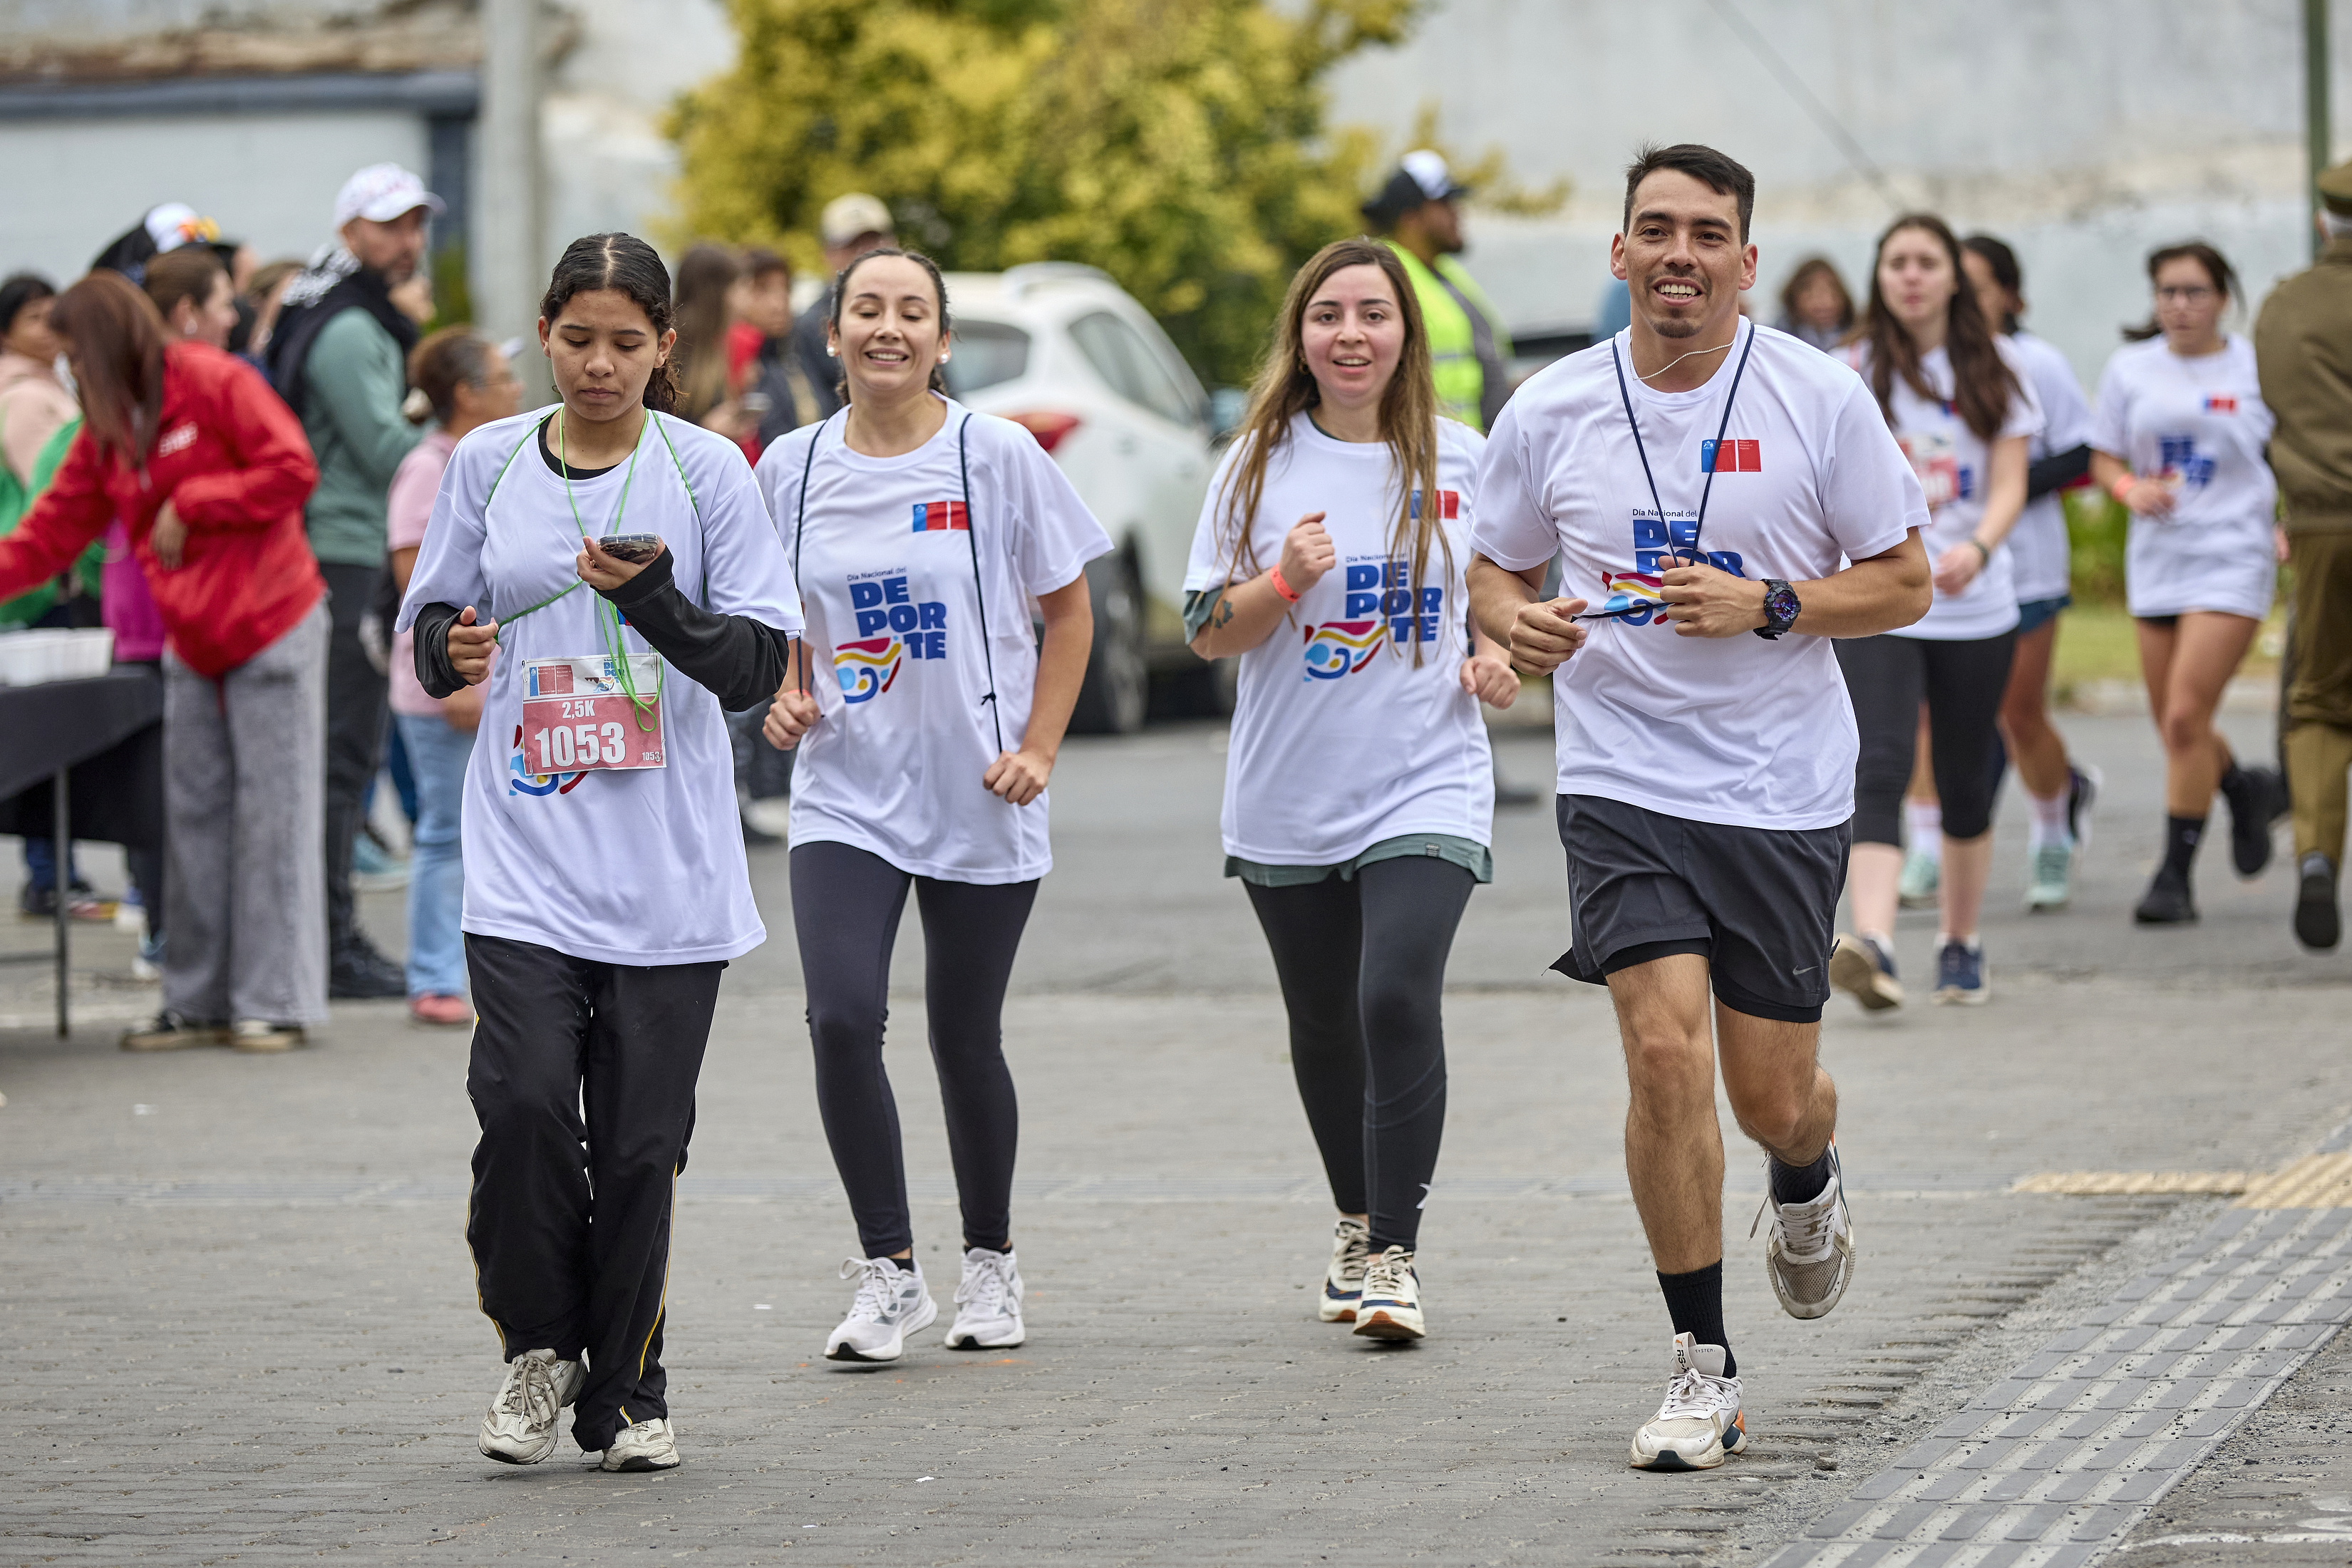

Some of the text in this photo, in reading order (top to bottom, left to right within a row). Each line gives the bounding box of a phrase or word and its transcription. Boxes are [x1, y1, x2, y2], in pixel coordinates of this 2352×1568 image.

[1648, 509, 1683, 517] Naional
[1633, 519, 1698, 549] DE
[860, 568, 894, 579] Nacional
[1346, 562, 1408, 592] DE
[849, 576, 910, 610] DE
[1345, 587, 1443, 619] POR
[855, 602, 947, 638] POR
[1390, 616, 1439, 644] TE
[902, 631, 947, 660] TE
[562, 699, 596, 720] 2,5K
[535, 721, 626, 768] 1053
[641, 751, 660, 761] 1053
